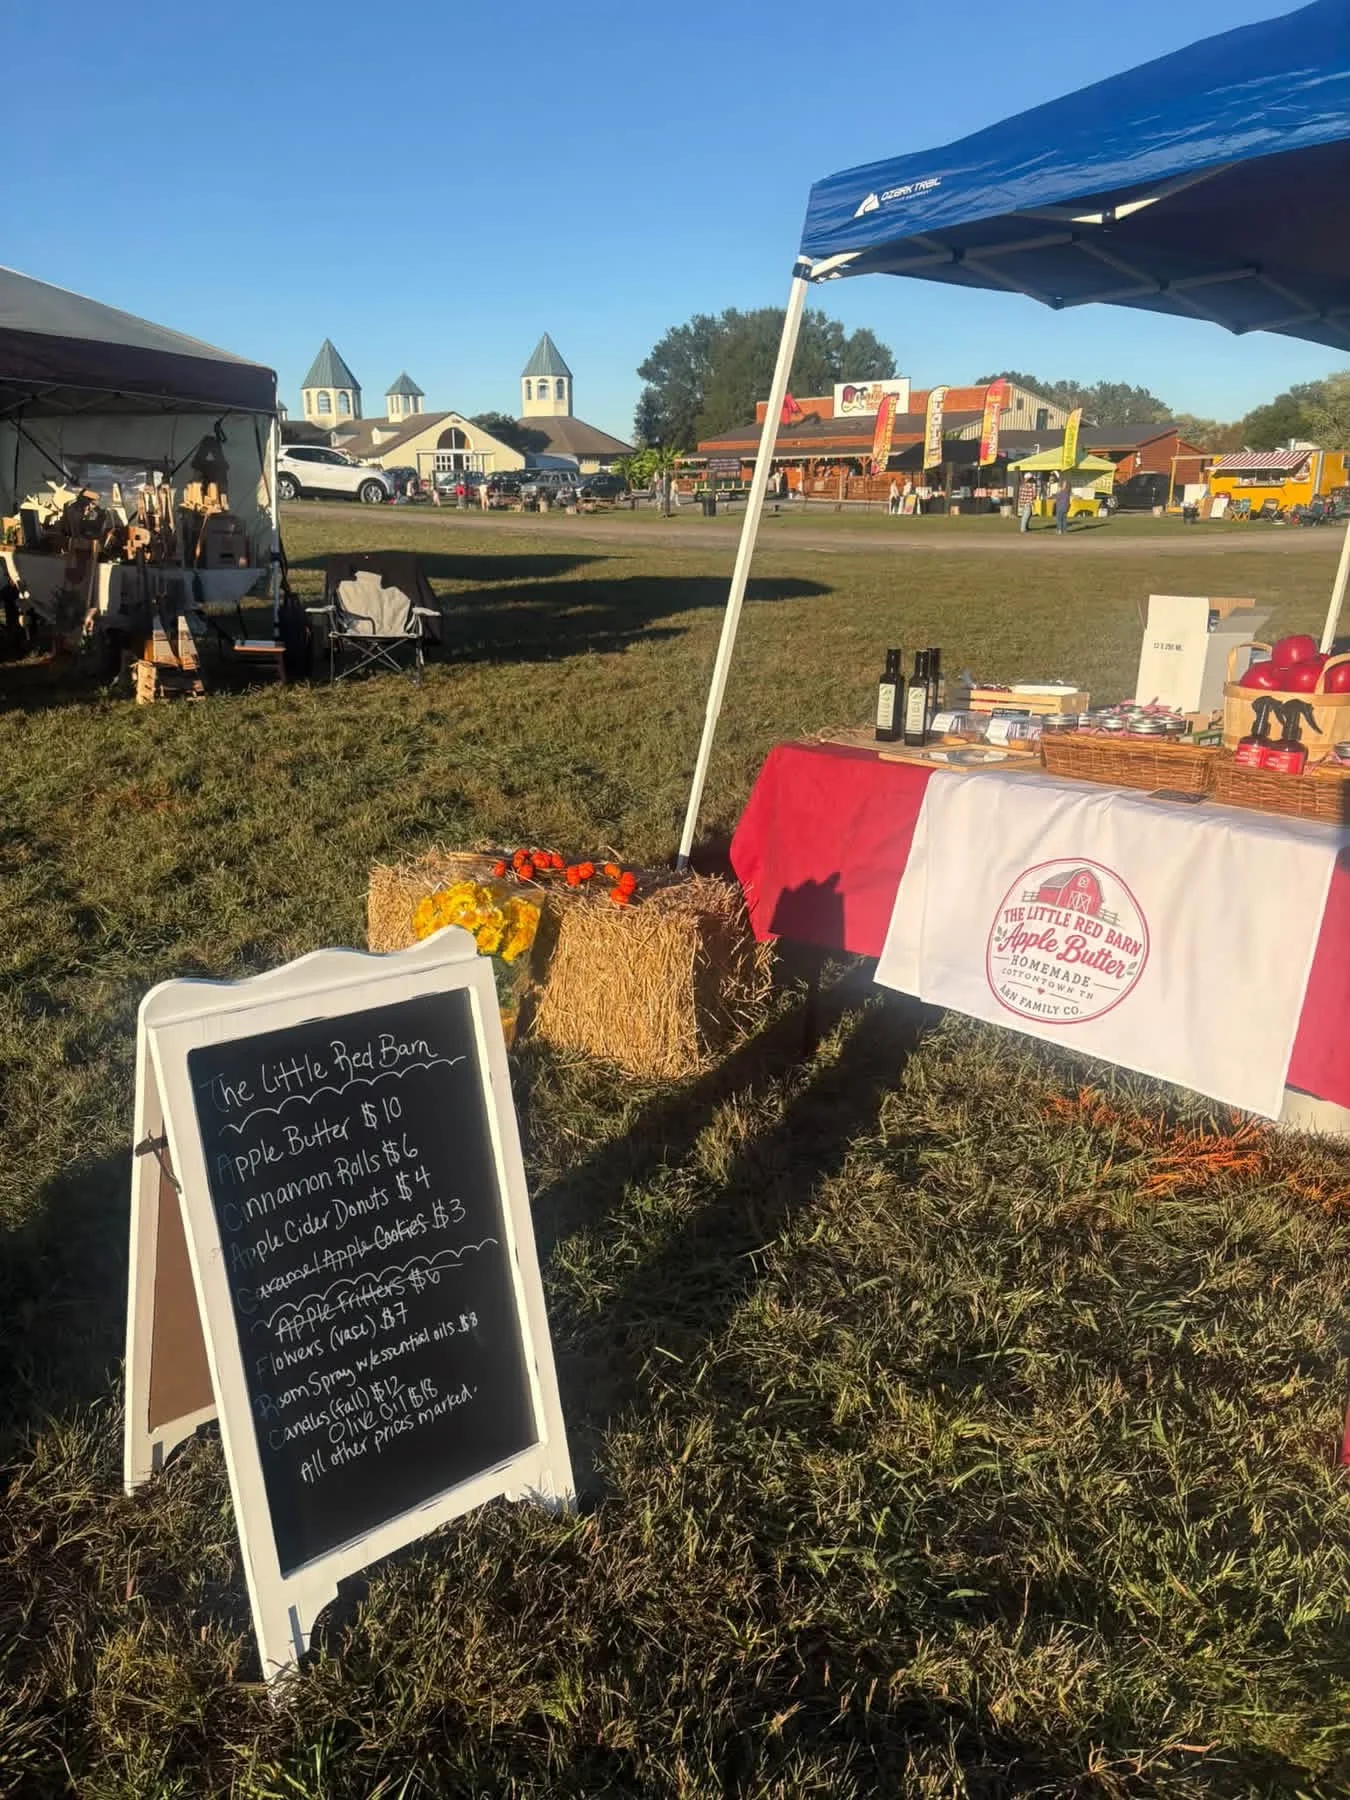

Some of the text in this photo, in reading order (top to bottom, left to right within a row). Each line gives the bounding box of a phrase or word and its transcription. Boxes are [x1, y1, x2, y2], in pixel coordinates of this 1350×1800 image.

[997, 922, 1127, 980] Apple Butter
[1004, 906, 1143, 957] THE LITTLE RED BARN
[999, 983, 1018, 1002] A&N
[1018, 996, 1060, 1016] FAMILY
[1001, 967, 1075, 995] COTTONTOWN
[1010, 954, 1092, 988] HOMEMADE
[200, 1033, 439, 1113] The Little Red Barn
[216, 1096, 402, 1184] Apple Butter $10
[223, 1132, 419, 1232] Cinnamon Rolls $6
[230, 1165, 432, 1273] Apple Cider Donuts $4
[236, 1198, 467, 1314] Caramel Apple Cookies $3
[256, 1301, 409, 1382] Flowers (vase) $7
[274, 1301, 337, 1344] Apple
[336, 1277, 407, 1312] Fritters
[255, 1383, 309, 1421] Room
[307, 1366, 357, 1400] Spray
[432, 1319, 456, 1341] oils
[267, 1375, 405, 1451] Candles (fall) $12
[328, 1377, 439, 1445] Olive Oil $18
[300, 1450, 327, 1485] All
[330, 1435, 368, 1467] other
[373, 1412, 416, 1452] prices
